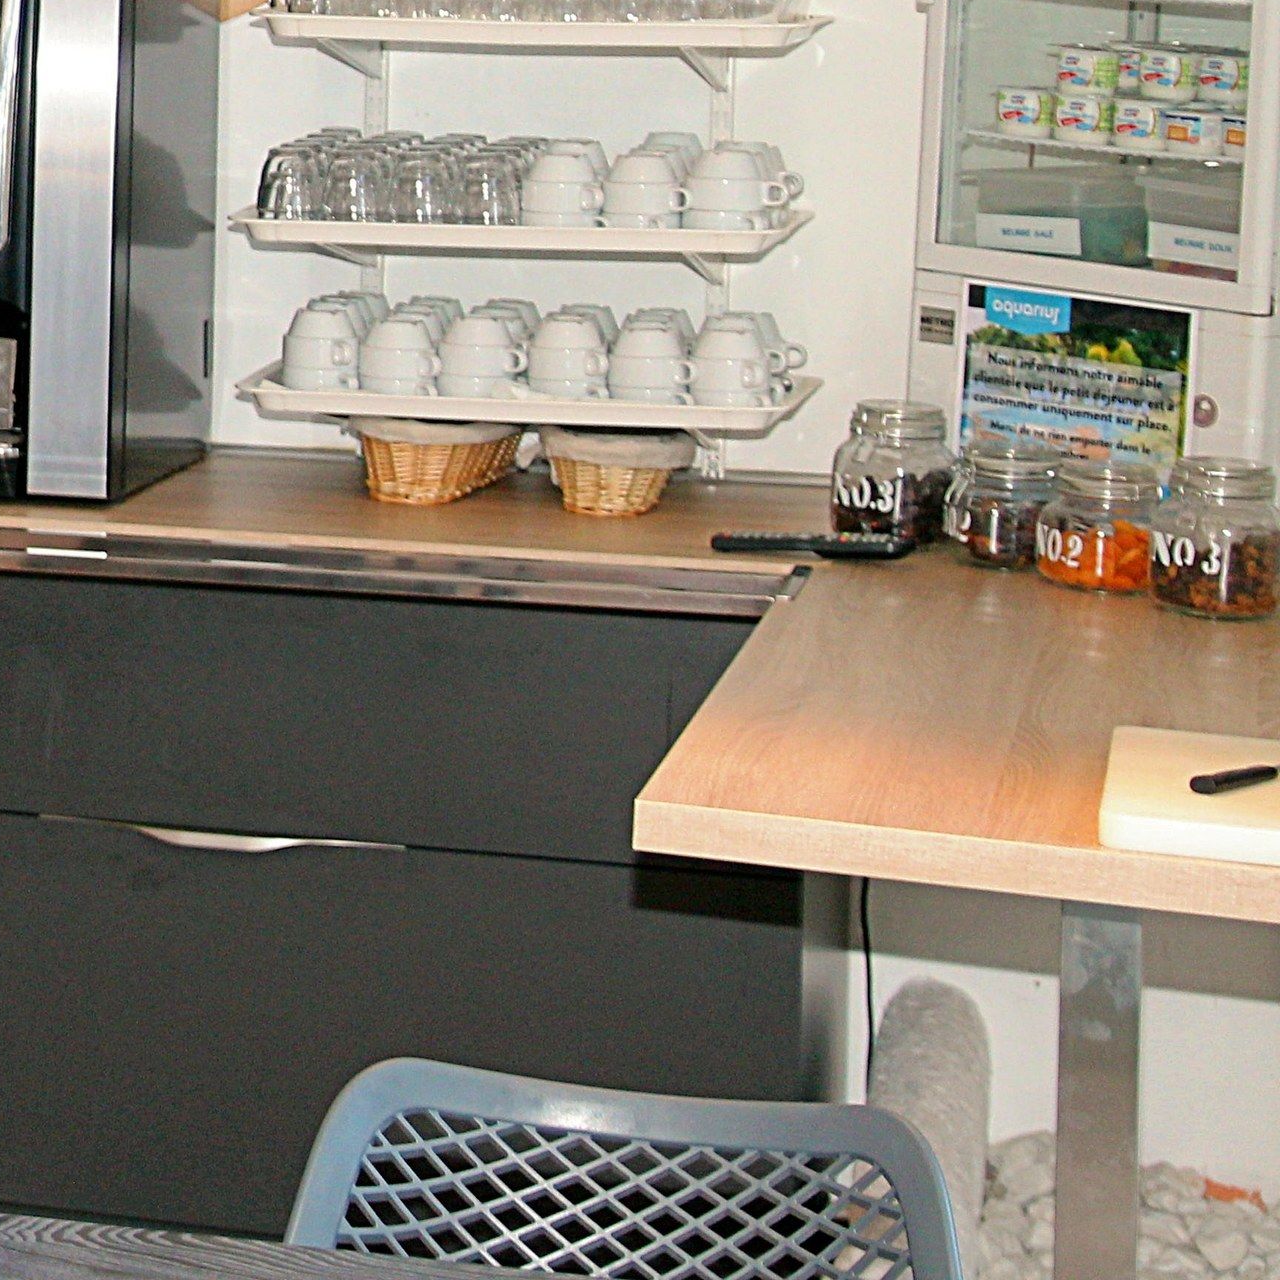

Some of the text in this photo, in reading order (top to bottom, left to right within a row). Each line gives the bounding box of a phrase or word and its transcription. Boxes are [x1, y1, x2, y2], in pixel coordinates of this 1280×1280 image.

[989, 351, 1164, 390] Nous informons notre aimable
[973, 392, 1038, 410] consommer
[1042, 402, 1113, 423] uniquement
[1116, 414, 1134, 426] sur
